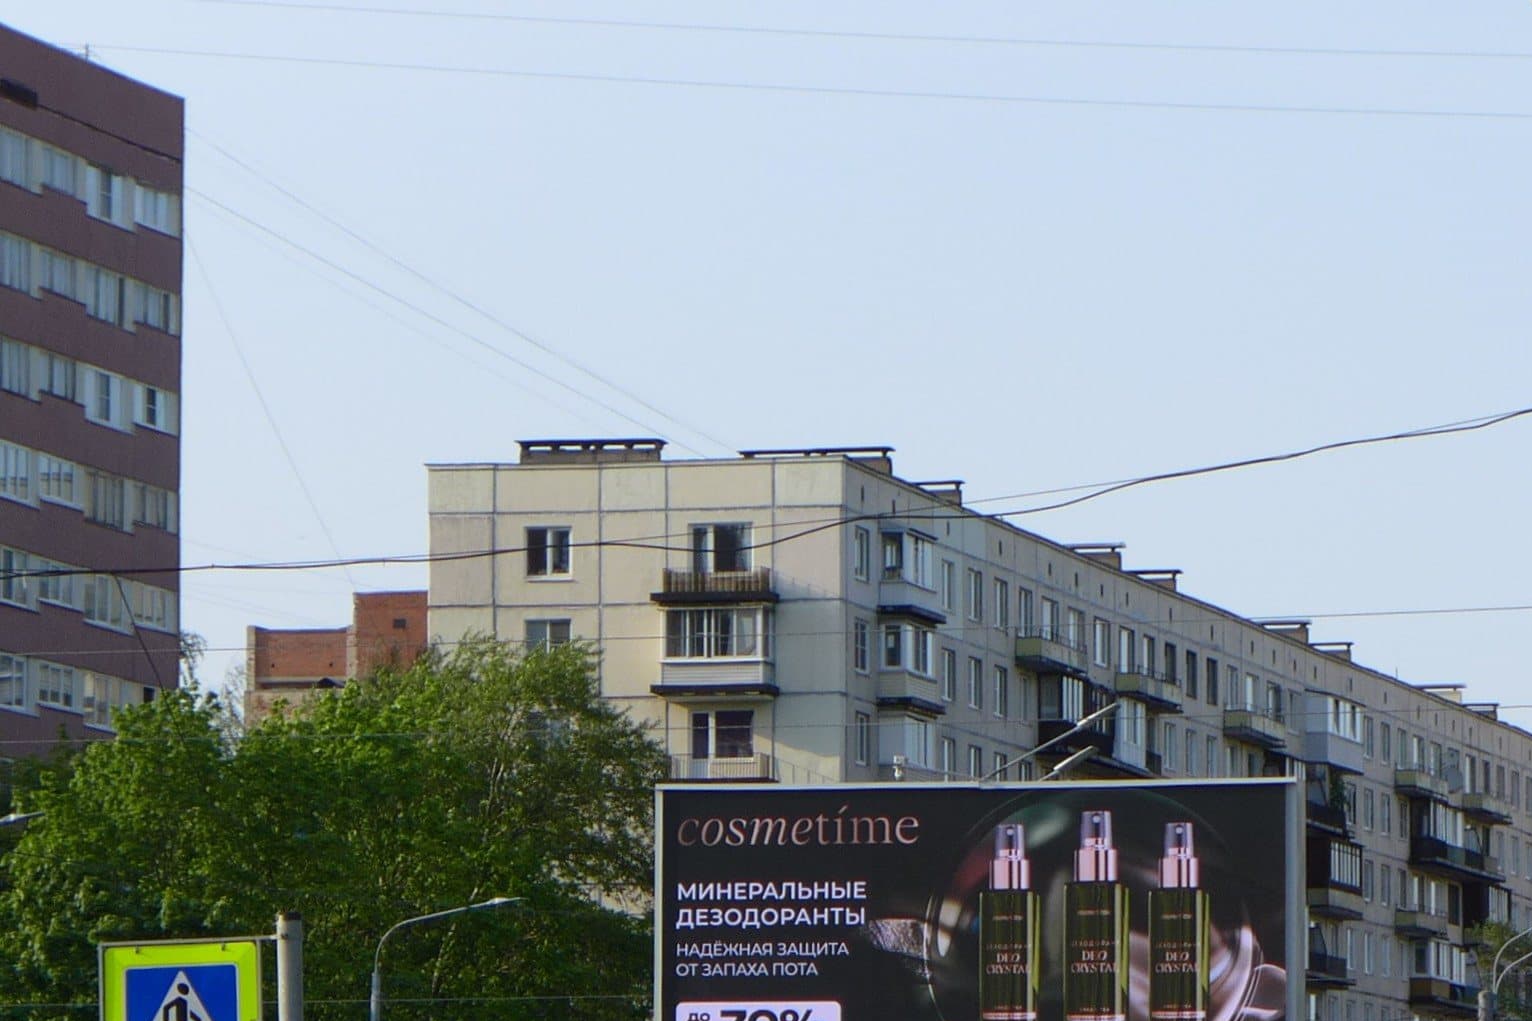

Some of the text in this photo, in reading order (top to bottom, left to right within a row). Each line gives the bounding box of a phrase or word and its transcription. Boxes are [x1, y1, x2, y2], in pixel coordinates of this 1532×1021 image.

[676, 881, 868, 902] МИНЕРАЛЬНЫЕ
[675, 906, 867, 930] ДЕЗОДОРАНТЫ
[675, 940, 850, 959] НАДЁЖНАЯ ЗАЩИТА
[675, 961, 819, 977] ОТ ЗАПАХА ПОТА
